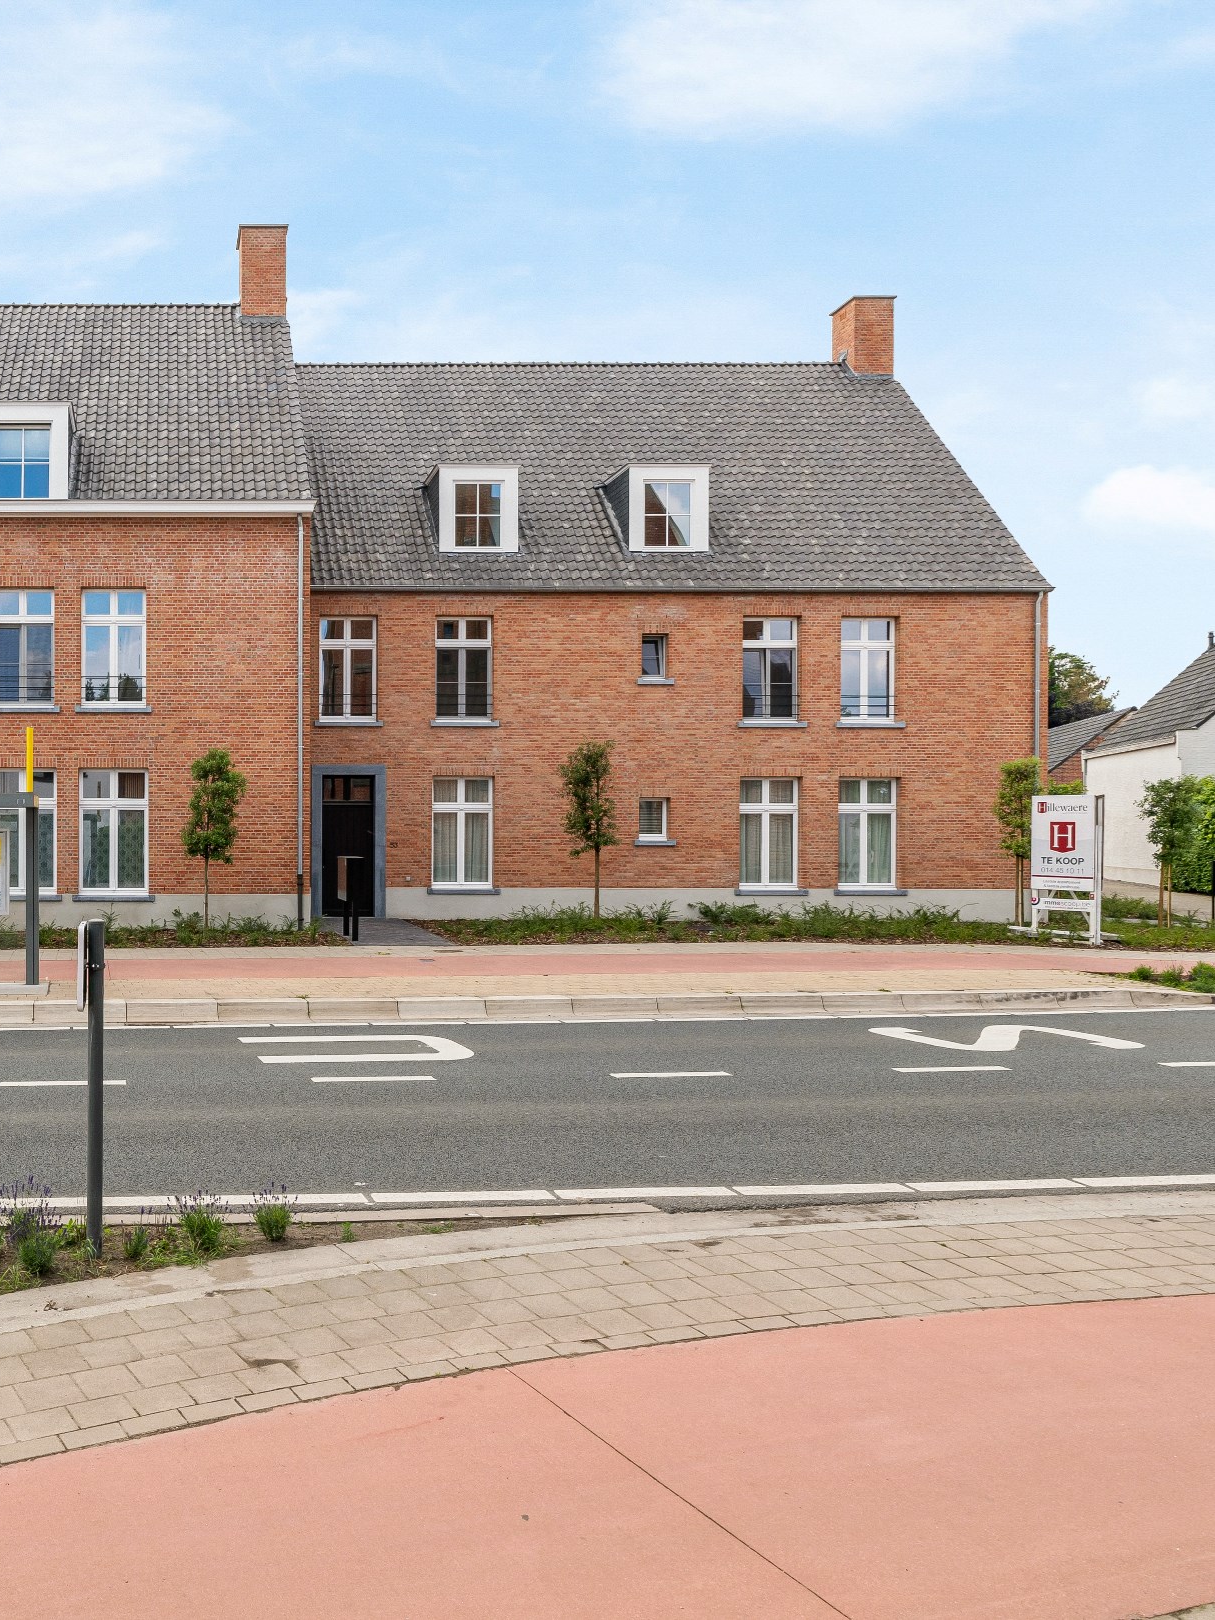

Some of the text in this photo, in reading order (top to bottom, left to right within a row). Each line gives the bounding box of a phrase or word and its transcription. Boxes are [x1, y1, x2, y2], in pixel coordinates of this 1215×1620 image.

[1037, 801, 1088, 813] Hillewaere
[1051, 824, 1074, 849] H
[1040, 856, 1085, 865] TE KOOP
